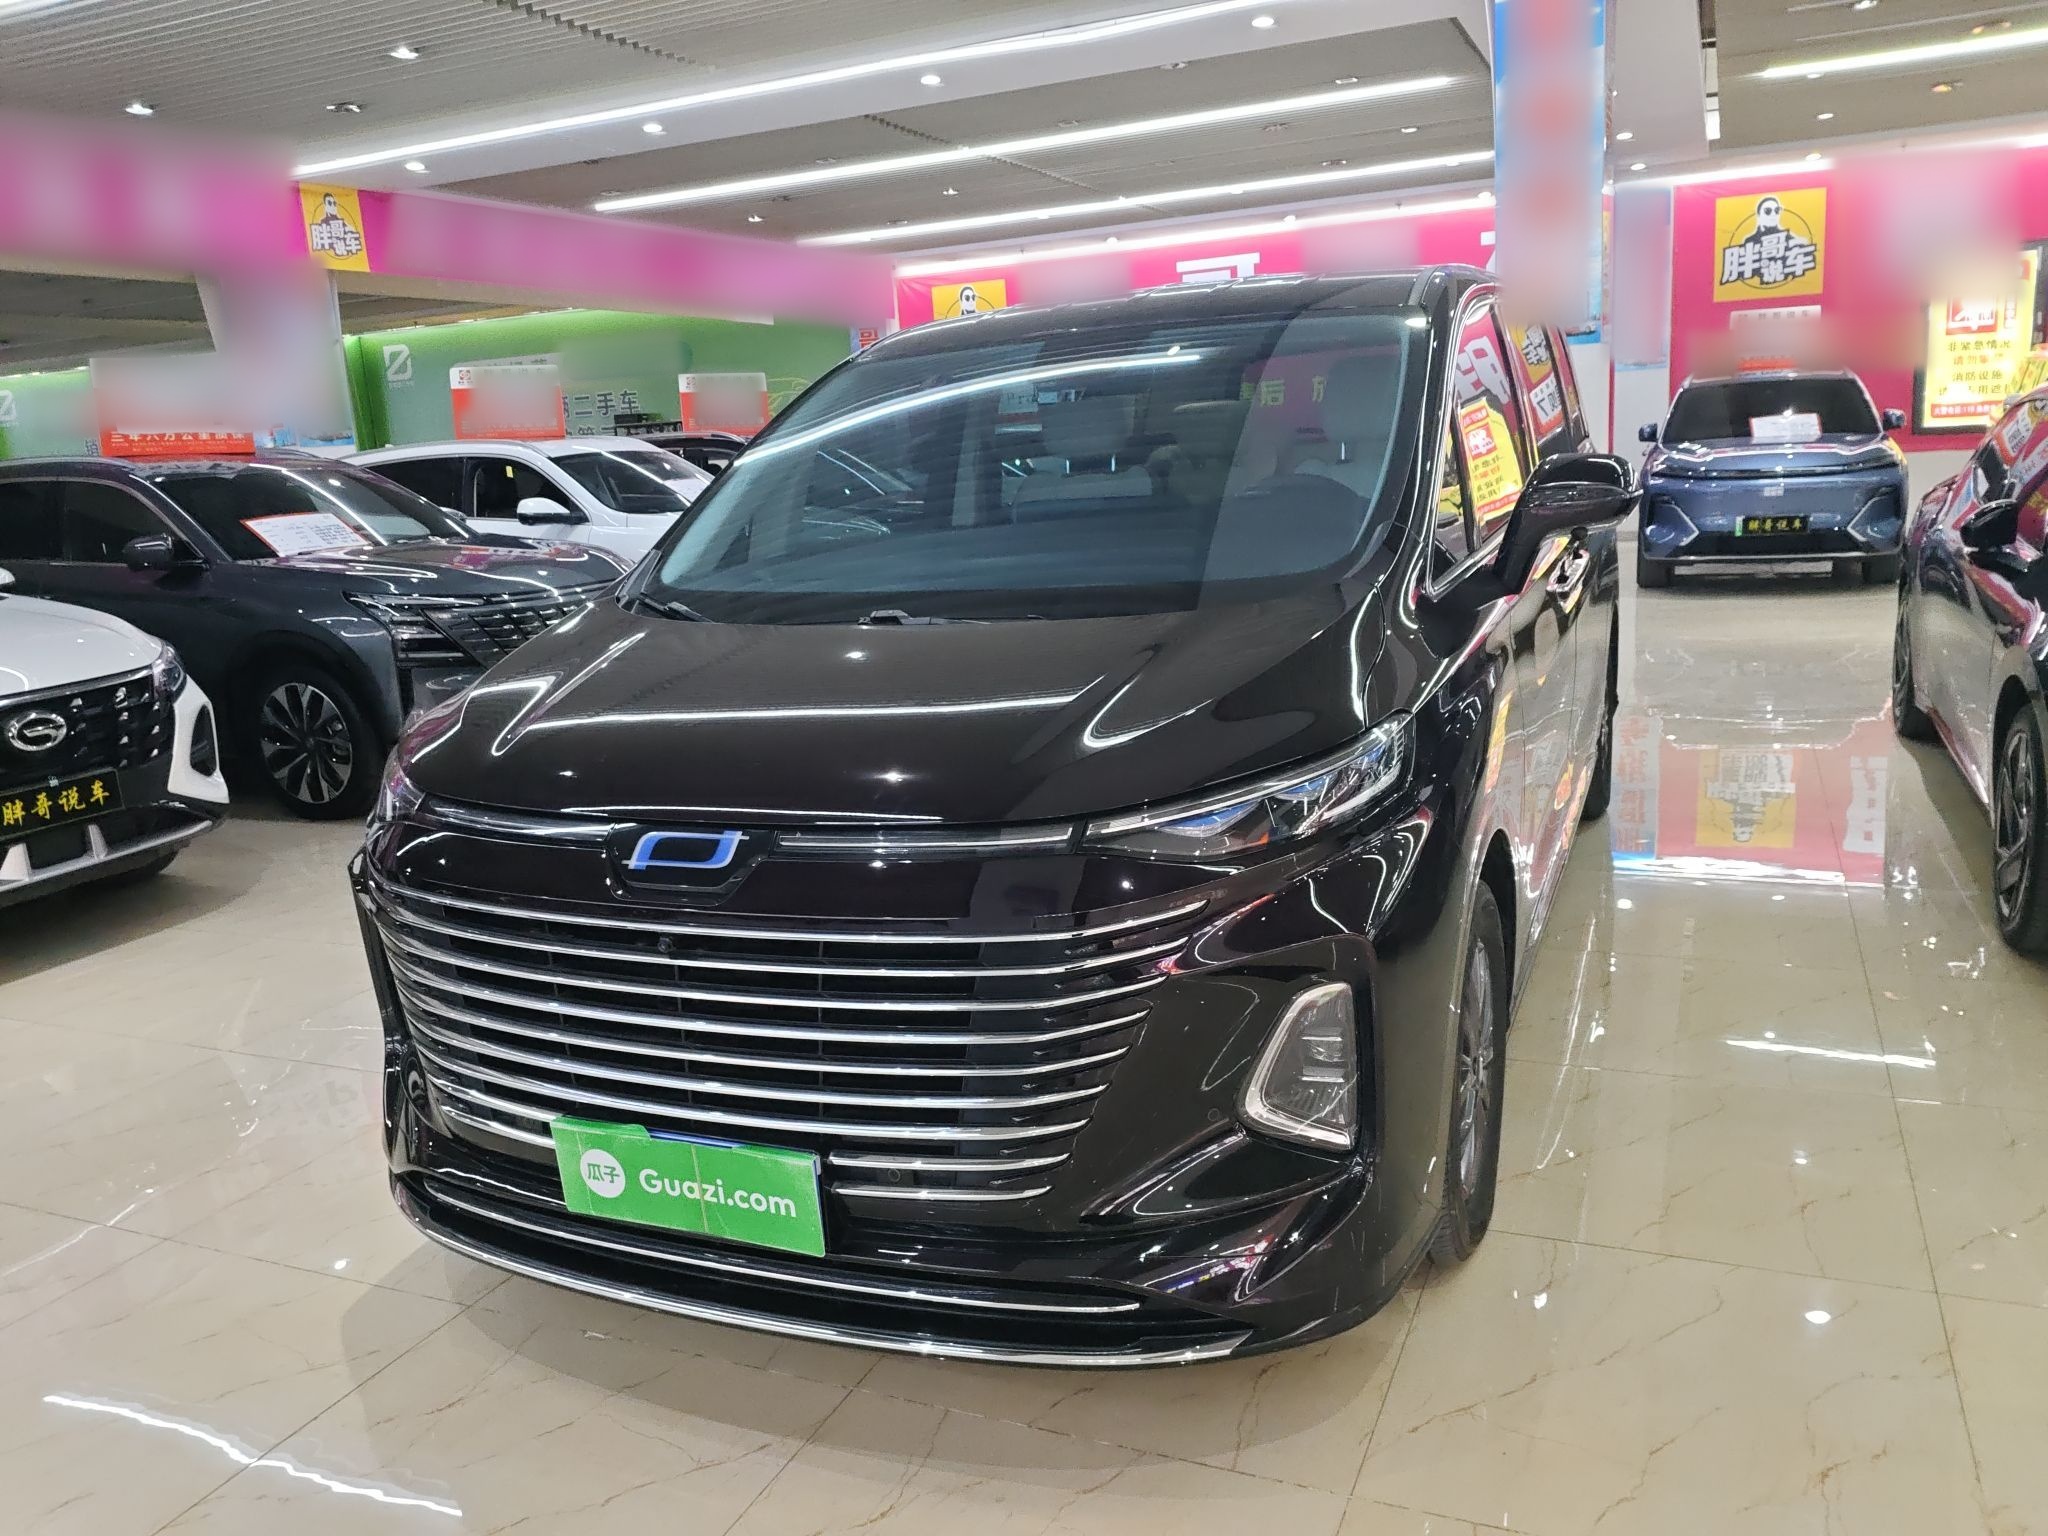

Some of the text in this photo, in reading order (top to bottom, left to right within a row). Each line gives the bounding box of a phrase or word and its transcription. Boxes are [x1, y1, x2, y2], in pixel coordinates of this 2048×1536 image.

[1720, 230, 1817, 285] 胖哥说车
[2, 779, 110, 827] 胖哥说车
[586, 1162, 621, 1184] 瓜子
[638, 1168, 798, 1218] Guazi.com
